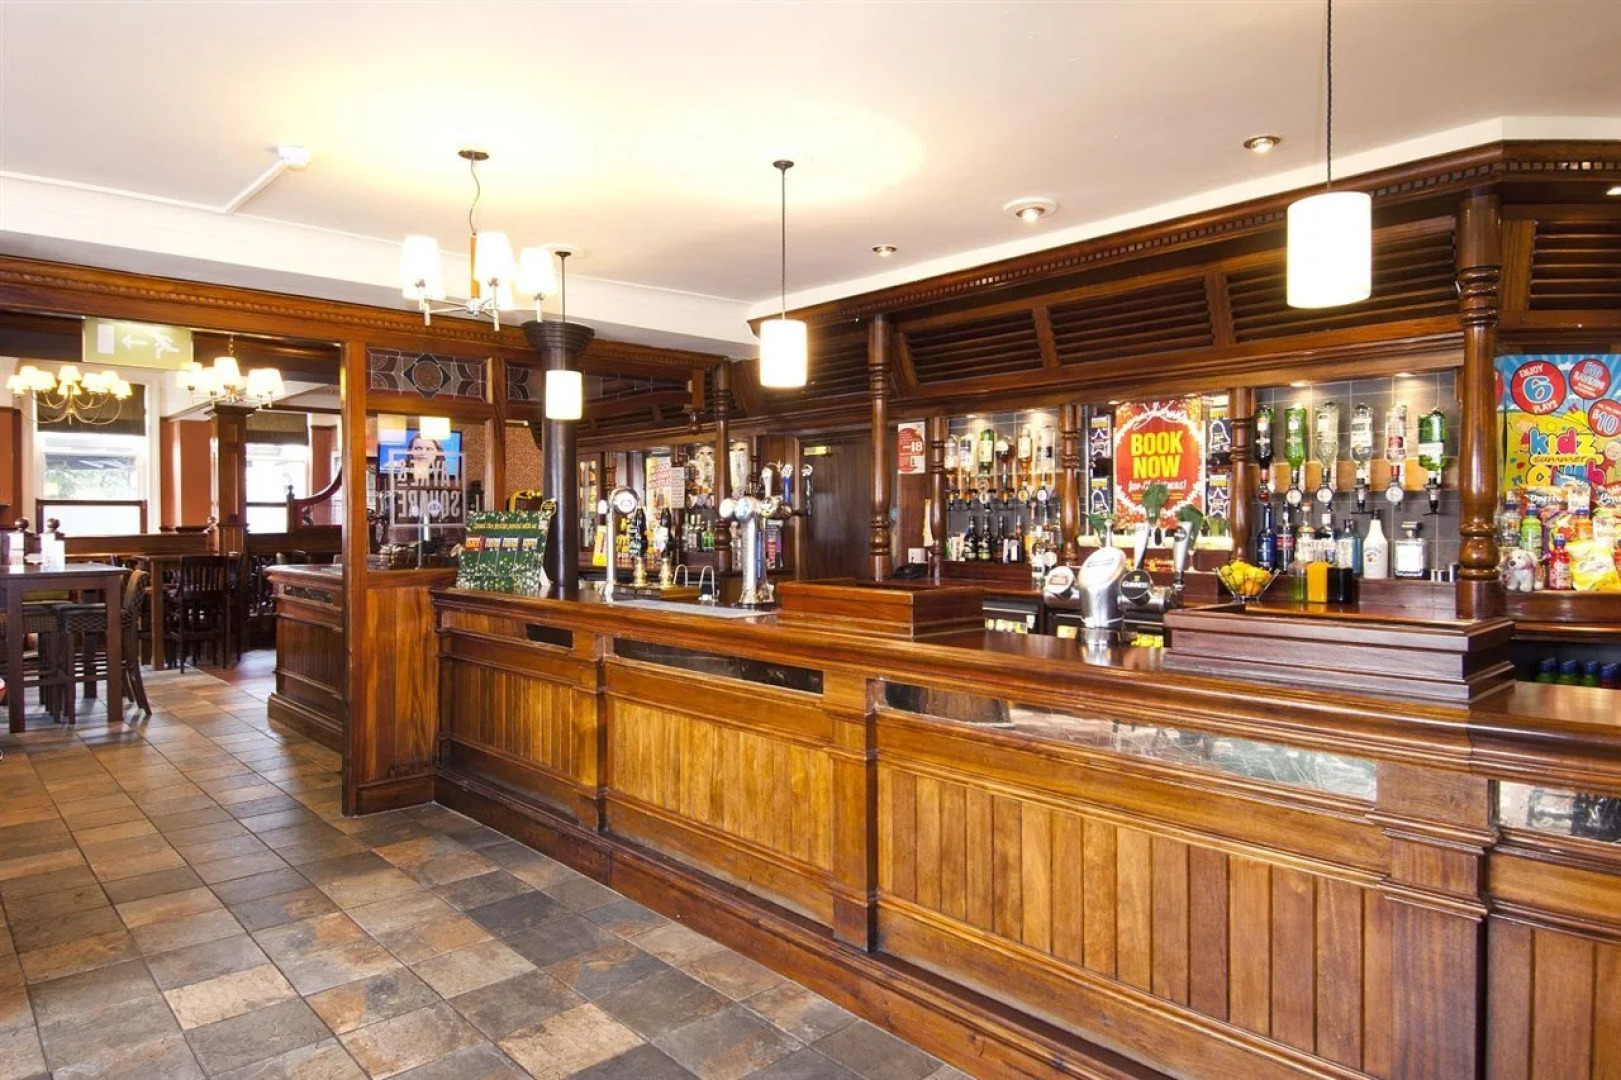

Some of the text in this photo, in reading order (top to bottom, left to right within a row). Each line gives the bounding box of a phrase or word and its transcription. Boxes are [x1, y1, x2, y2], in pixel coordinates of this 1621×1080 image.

[1519, 364, 1544, 378] ENJOY
[1522, 375, 1554, 404] 6
[1533, 399, 1559, 414] PLAYS
[1131, 431, 1183, 457] BOOK
[1529, 427, 1597, 456] kidz
[1132, 456, 1182, 480] NOW
[1533, 455, 1588, 463] summer
[1527, 460, 1606, 487] cub
